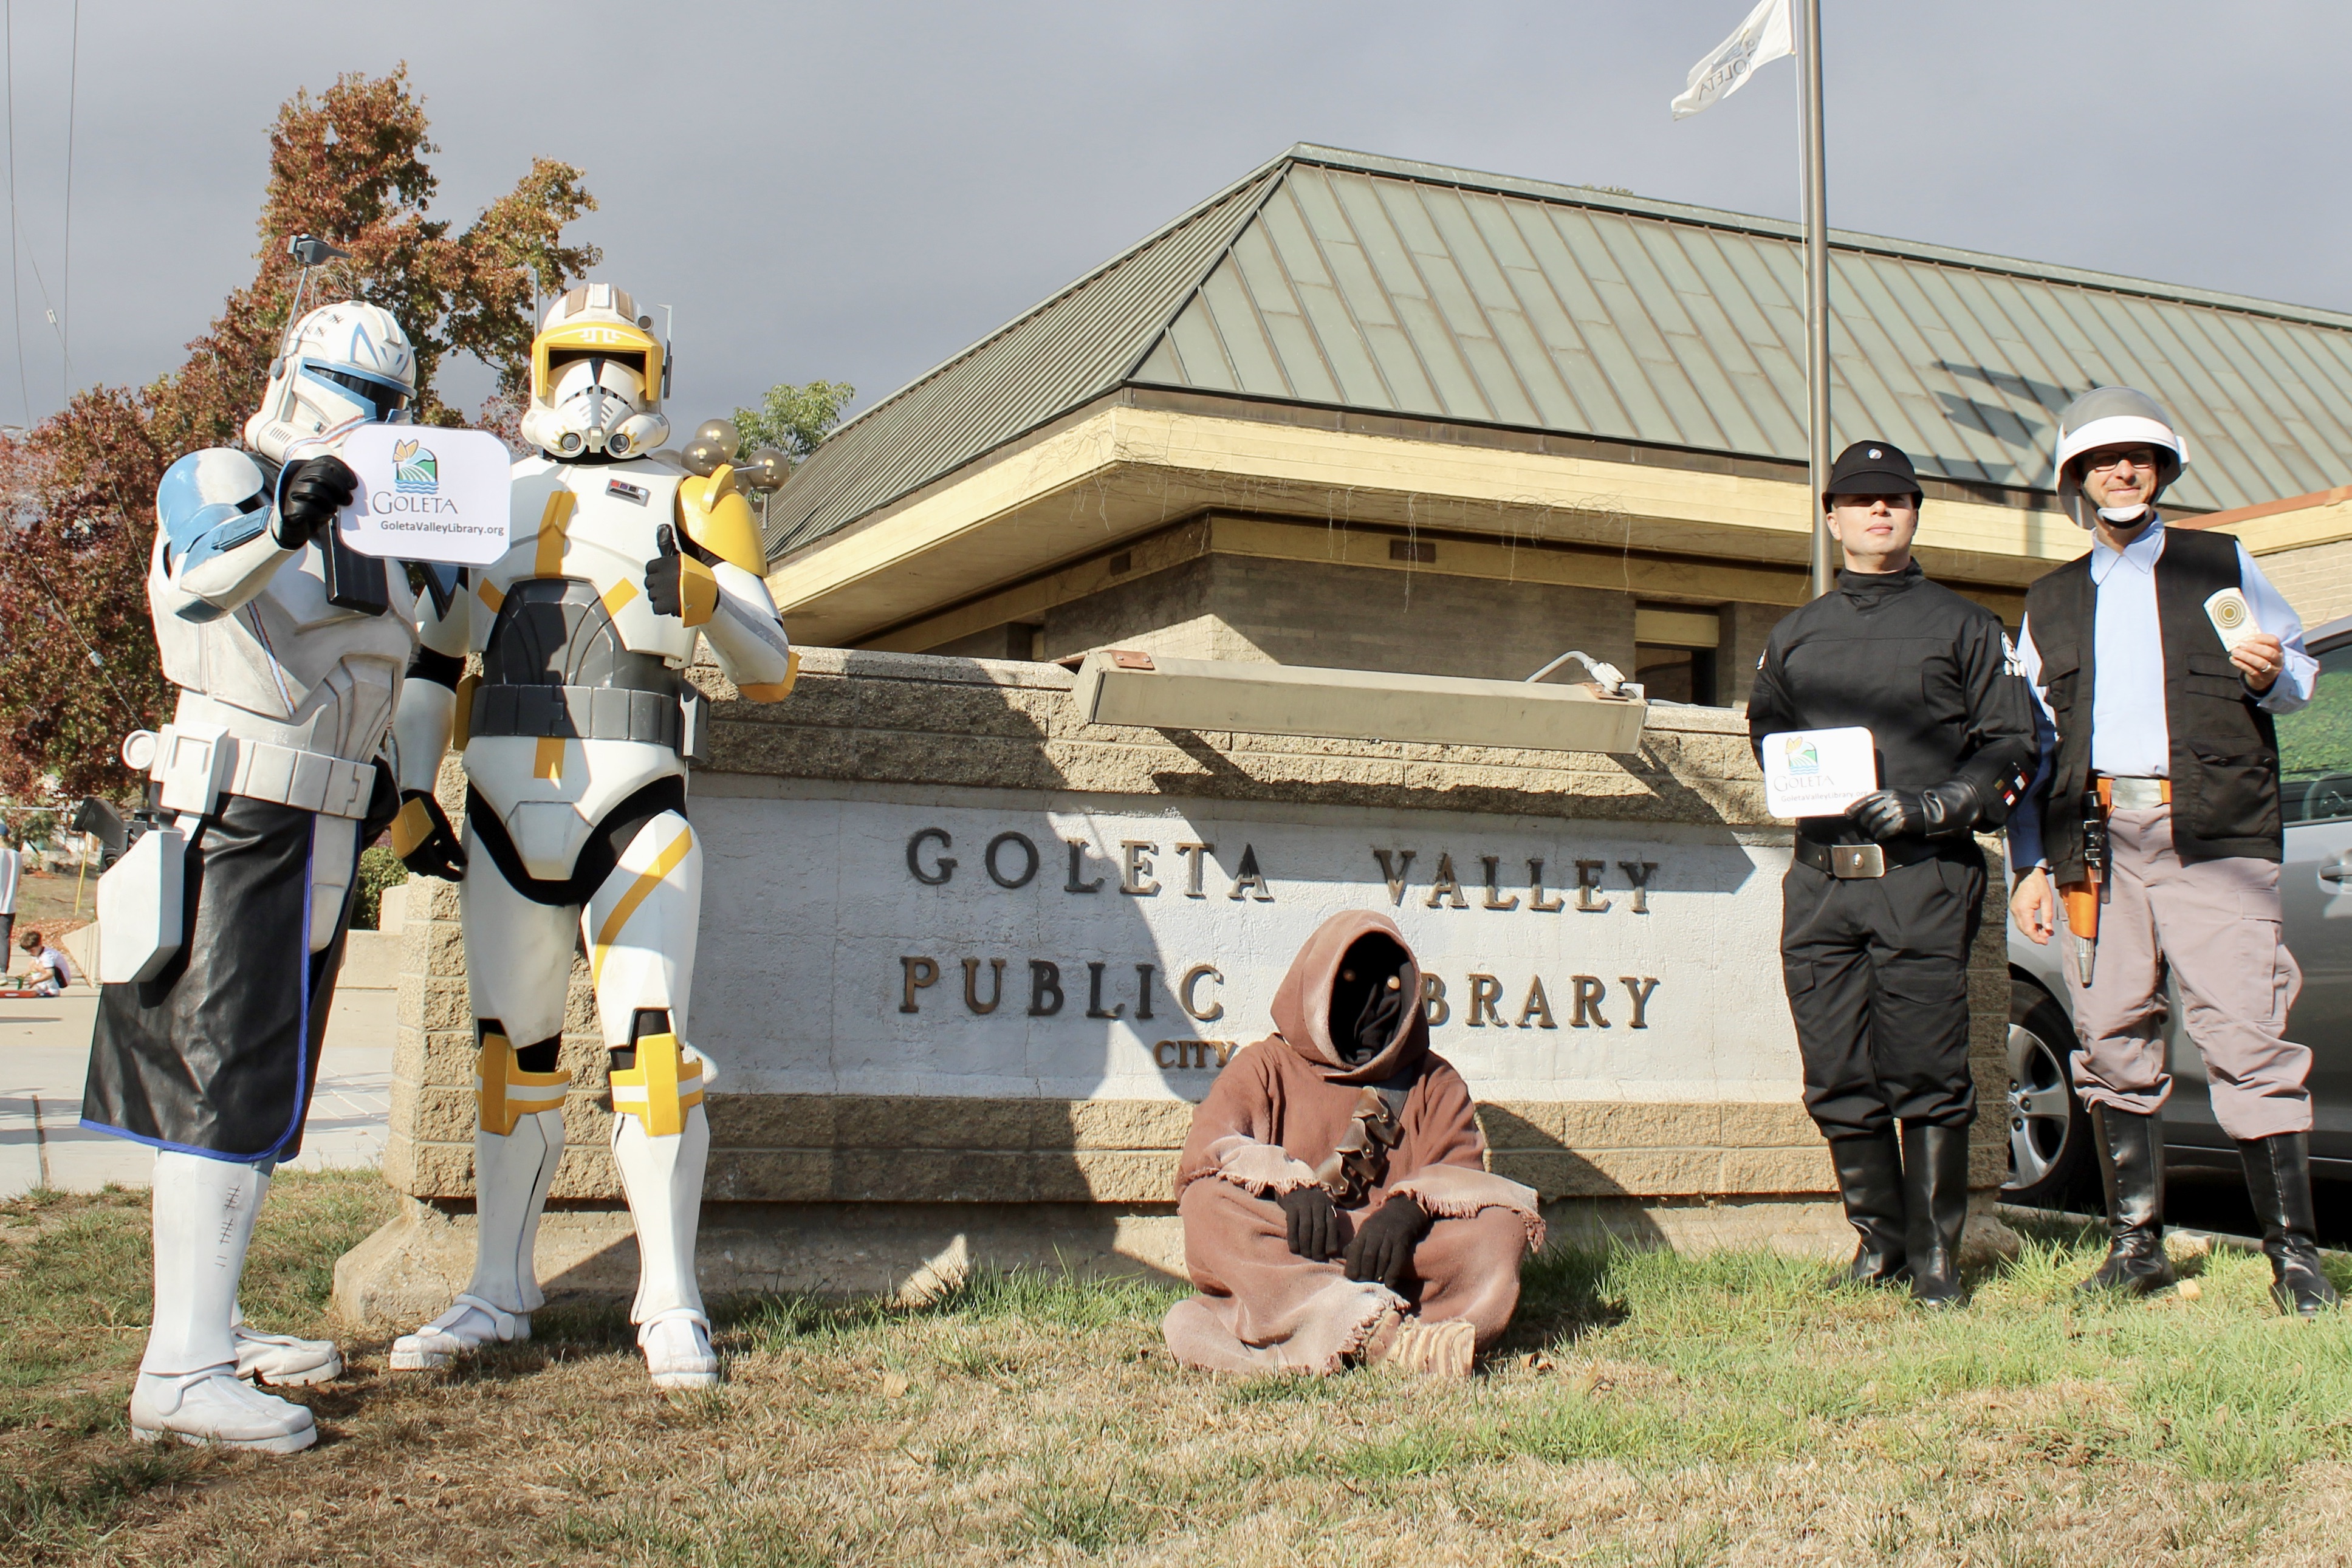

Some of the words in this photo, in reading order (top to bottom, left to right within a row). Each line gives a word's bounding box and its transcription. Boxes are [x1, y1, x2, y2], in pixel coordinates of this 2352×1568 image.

[372, 491, 458, 515] GOLETA
[380, 521, 504, 536] GoletaValleyLibrary.org
[1774, 775, 1834, 792] GOLETA
[906, 826, 1274, 902] GOLETA
[1373, 849, 1659, 913] VALLEY
[899, 956, 1224, 1021] PUBLIC
[1420, 972, 1660, 1029] BRARY
[1153, 1039, 1239, 1069] CITY
